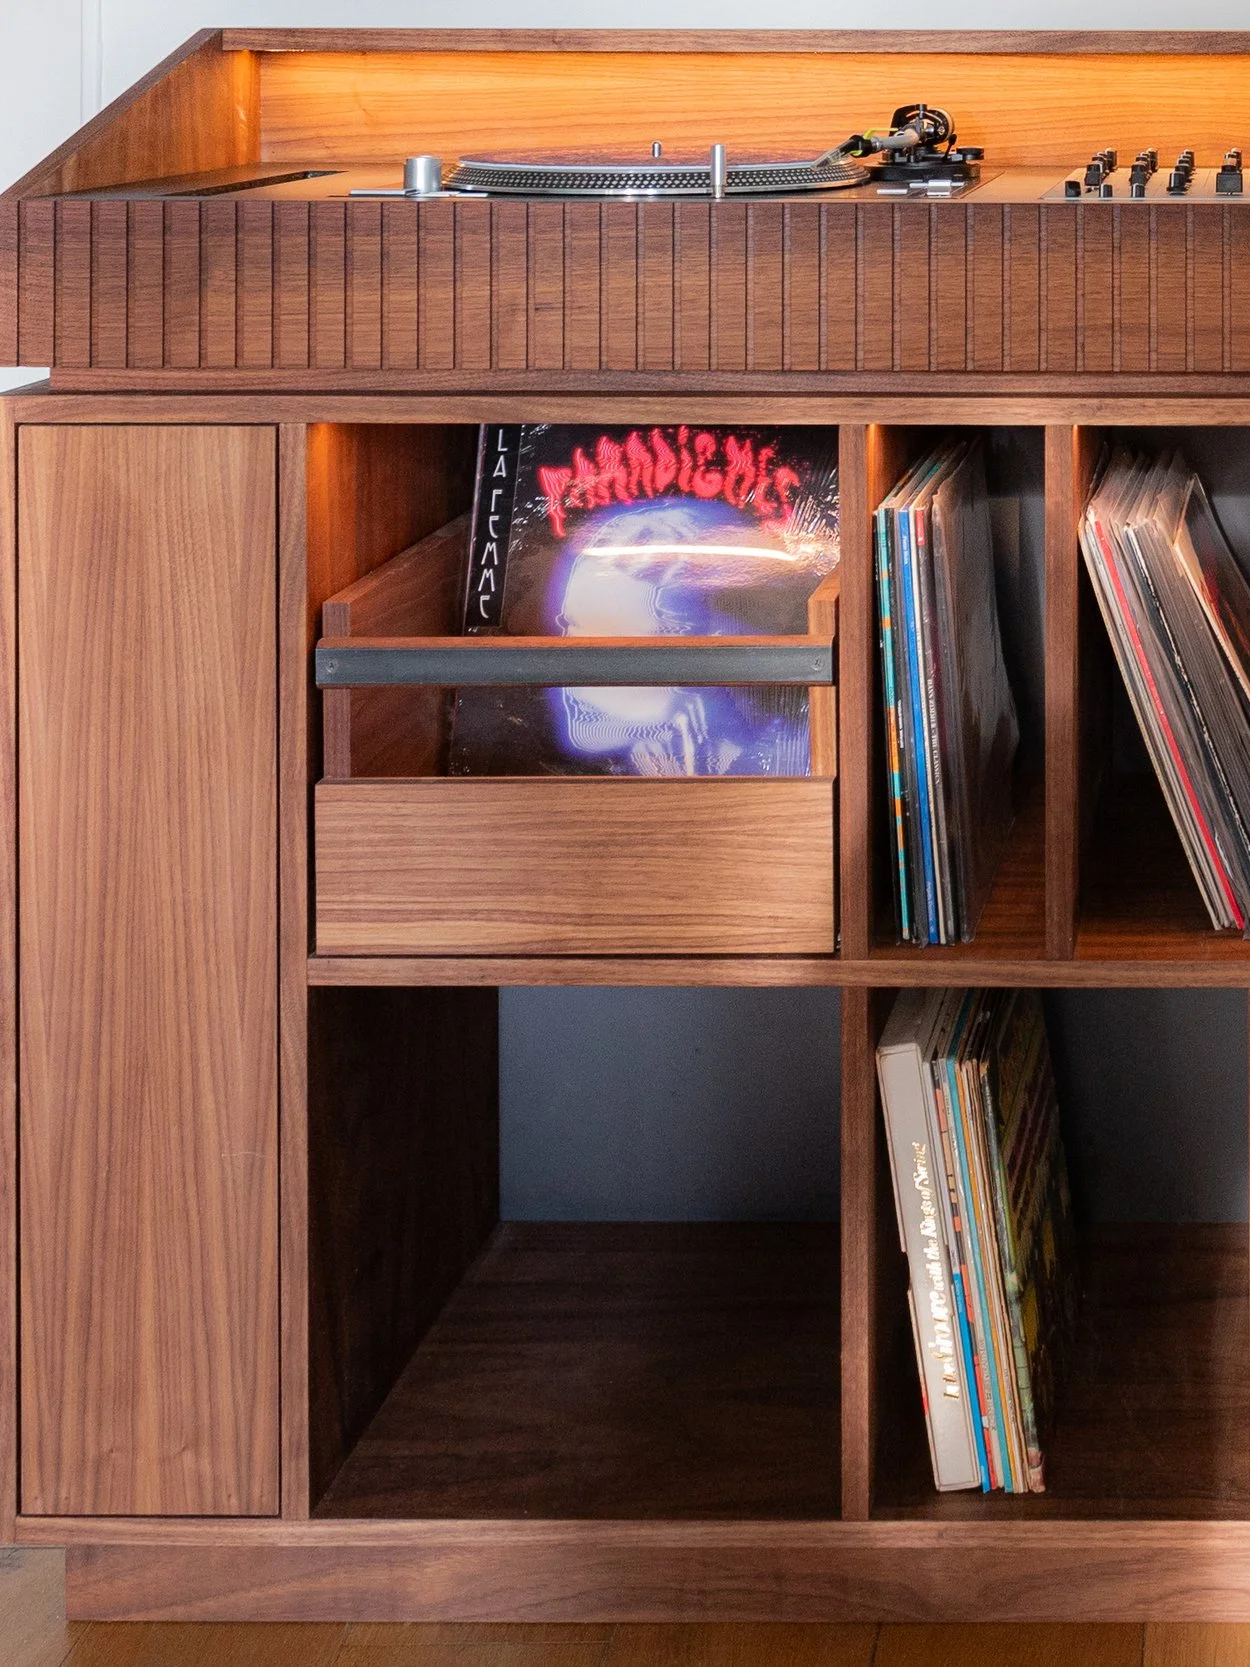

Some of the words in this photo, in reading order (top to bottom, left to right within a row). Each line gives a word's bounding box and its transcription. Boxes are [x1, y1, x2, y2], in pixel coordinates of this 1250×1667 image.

[492, 428, 508, 478] LA
[478, 489, 503, 619] FEMME
[919, 1200, 937, 1239] Kings
[923, 1239, 940, 1260] the
[926, 1261, 944, 1291] with
